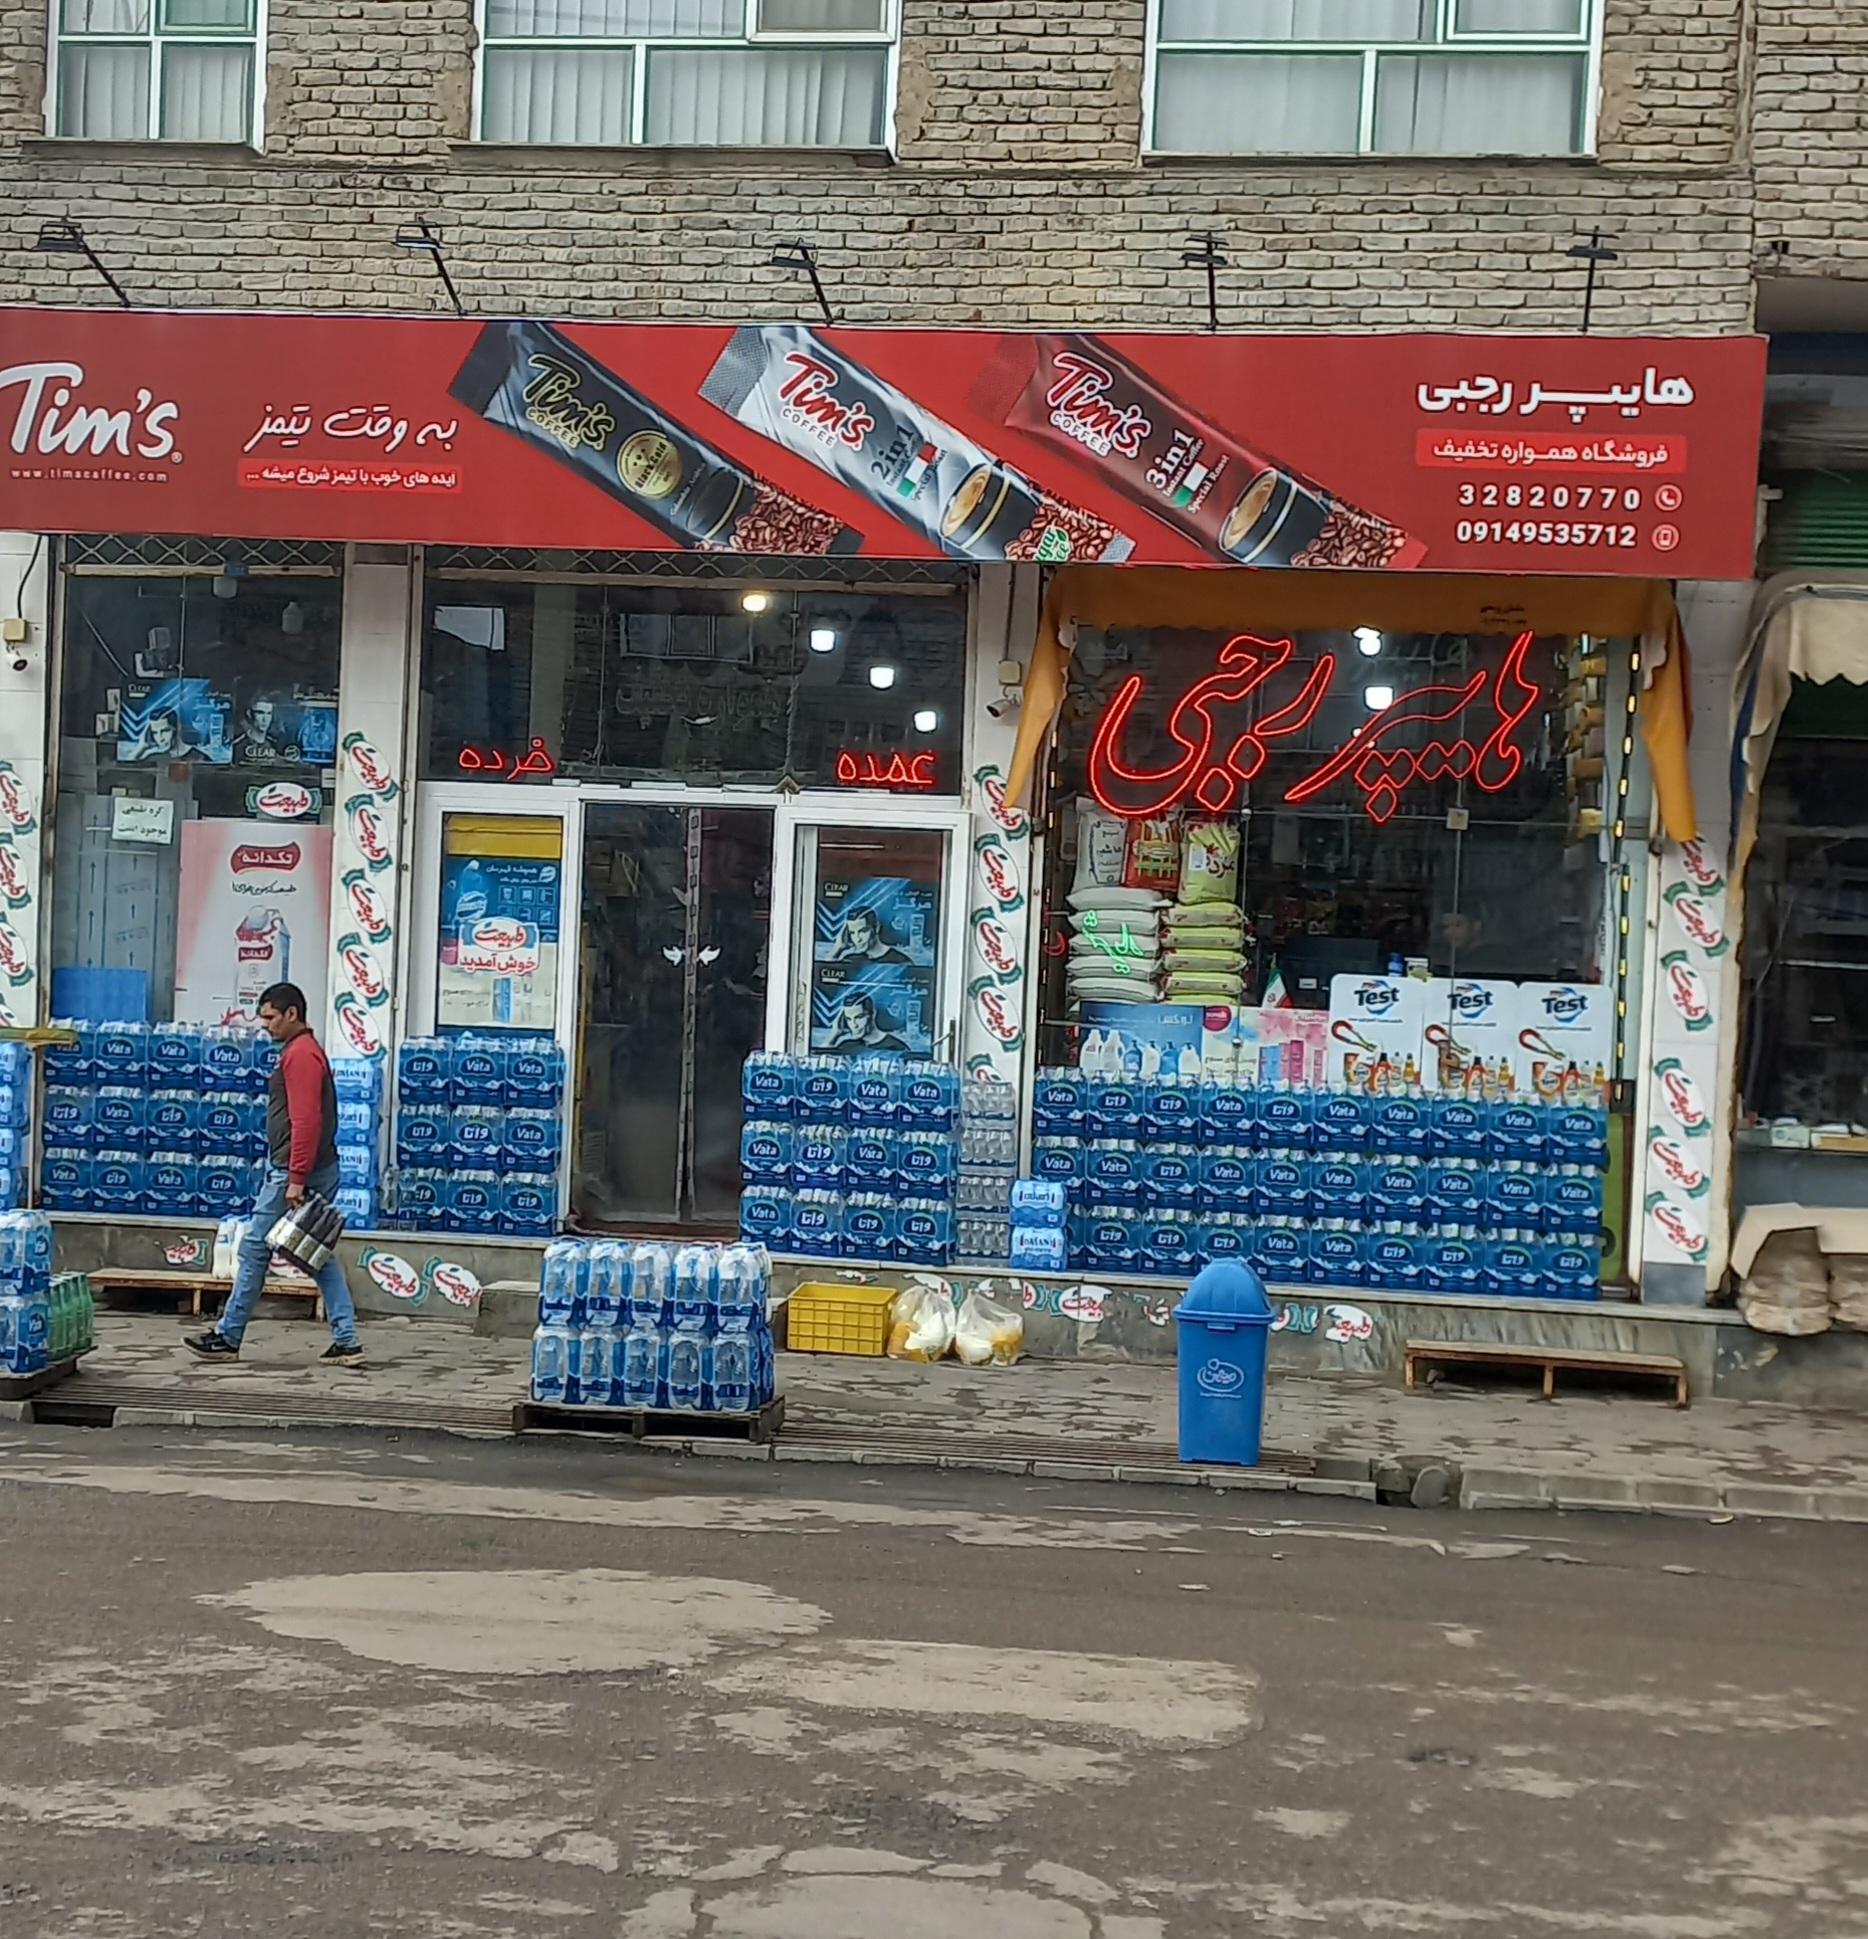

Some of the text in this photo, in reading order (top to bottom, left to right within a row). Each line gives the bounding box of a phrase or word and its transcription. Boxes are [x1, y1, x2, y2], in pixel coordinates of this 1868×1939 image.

[523, 353, 615, 446] Tim's
[779, 353, 873, 444] Tim's
[1417, 367, 1696, 424] هایپر رجبی
[0, 362, 178, 458] Tim's
[1049, 354, 1150, 453] Tim's
[243, 404, 458, 452] به وقت تیمز
[526, 407, 579, 448] COFFEE
[782, 408, 836, 447] COFFEE
[1052, 413, 1109, 455] COFFEE
[1433, 439, 1499, 460] تخفیف
[1580, 440, 1669, 468] فروشگاه
[297, 464, 330, 485] شروع
[331, 468, 357, 485] تیمز
[359, 468, 370, 485] با
[371, 468, 401, 486] خوب
[403, 471, 430, 488] های
[432, 472, 456, 487] ایده
[1456, 520, 1637, 547] 09149535712
[245, 744, 277, 758] CLEAR
[258, 785, 309, 813] طبیعت
[474, 921, 525, 948] طبیعت
[460, 952, 536, 972] خوش آمدید
[1354, 986, 1401, 1008] Test
[1447, 988, 1495, 1010] Test
[1541, 992, 1590, 1015] Test
[107, 1043, 131, 1055] Vata
[161, 1043, 186, 1056] Vata
[213, 1050, 240, 1062] Vata
[466, 1060, 490, 1072] Vata
[518, 1062, 542, 1074] Vata
[754, 1076, 780, 1088] Vata
[861, 1084, 887, 1097] Vata
[912, 1086, 938, 1098] Vata
[1048, 1090, 1074, 1103] Vata
[105, 1106, 130, 1118] Vata
[1215, 1100, 1242, 1112] Vata
[1329, 1105, 1356, 1118] Vata
[1387, 1108, 1414, 1122] Vata
[1446, 1110, 1473, 1124] Vata
[1505, 1114, 1532, 1128] Vata
[1565, 1117, 1592, 1131] Vata
[516, 1127, 541, 1140] Vata
[752, 1143, 777, 1155] Vata
[859, 1148, 883, 1160] Vata
[1045, 1158, 1071, 1171] Vata
[1101, 1160, 1128, 1173] Vata
[52, 1168, 77, 1181] Vata
[158, 1172, 181, 1185] Vata
[1214, 1166, 1240, 1180] Vata
[1270, 1169, 1296, 1182] Vata
[1325, 1172, 1352, 1185] Vata
[1385, 1176, 1412, 1189] Vata
[1442, 1178, 1469, 1191] Vata
[1502, 1182, 1530, 1195] Vata
[1561, 1186, 1588, 1200] Vata
[751, 1208, 776, 1220] Vata
[1268, 1236, 1294, 1250] Vata
[1325, 1241, 1352, 1254] Vata
[371, 1257, 417, 1294] طبیعت
